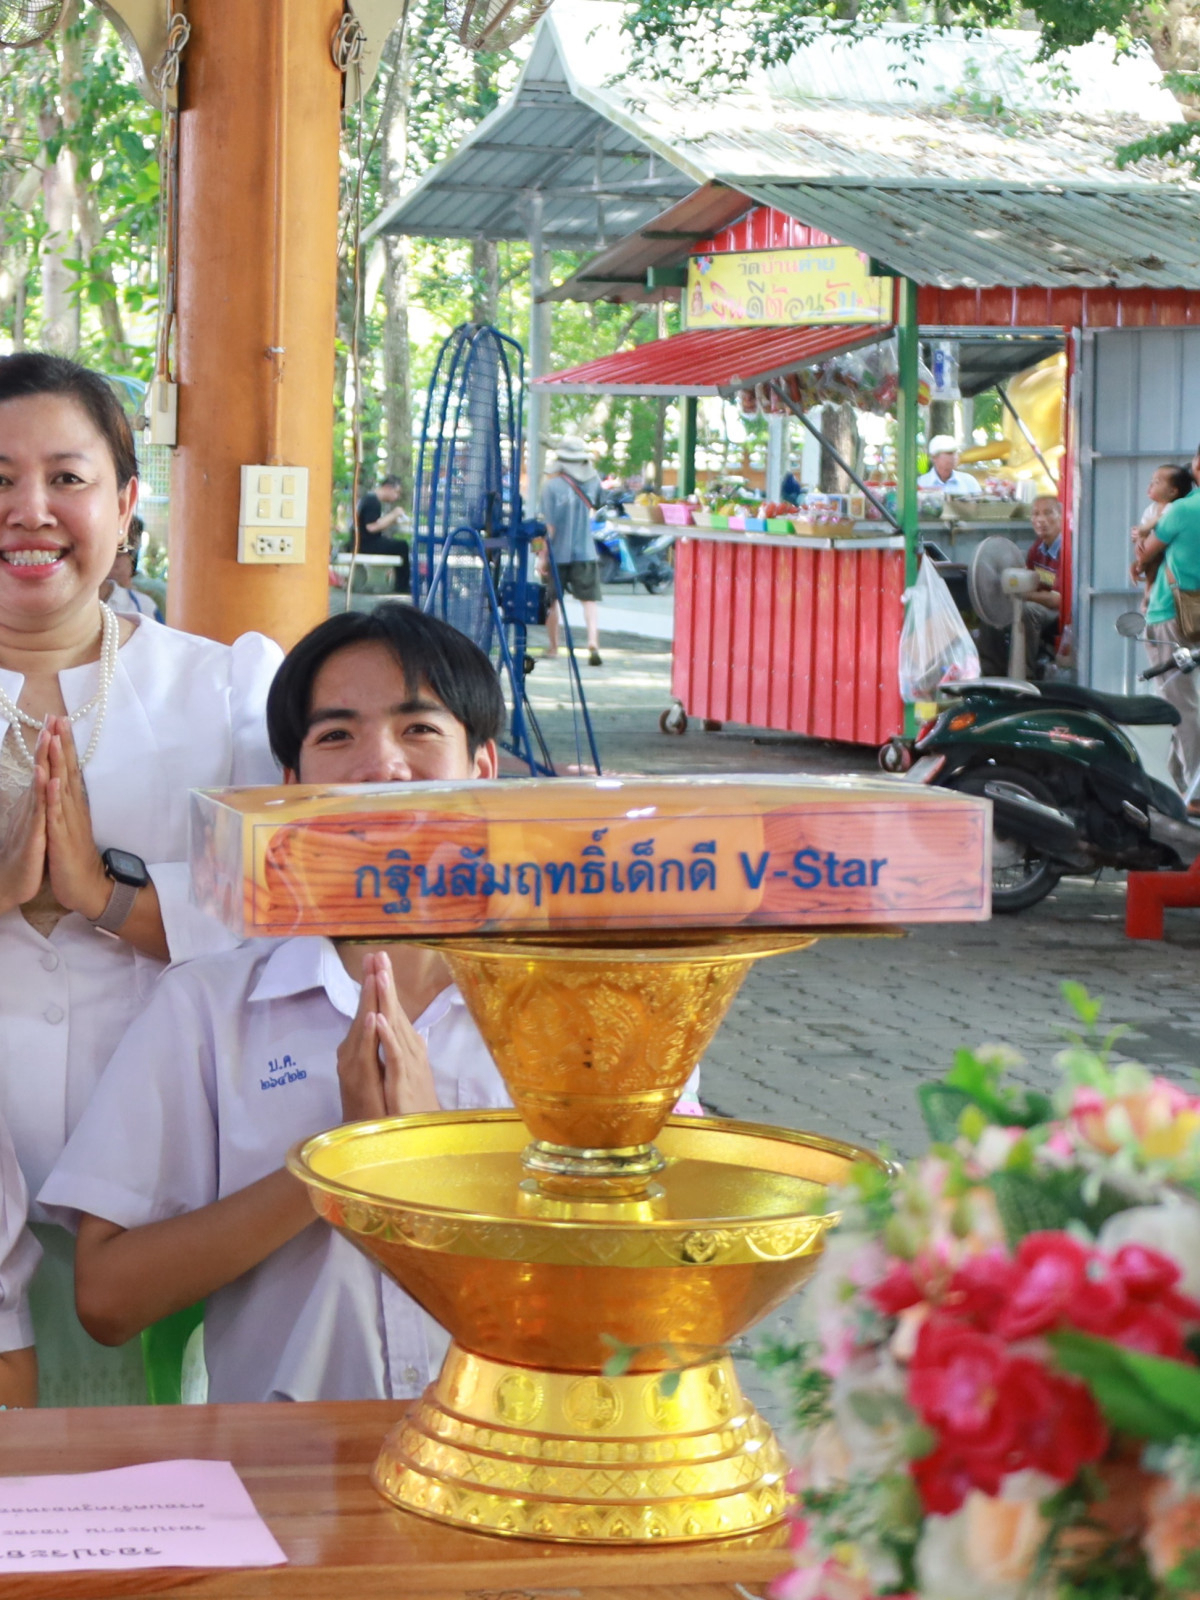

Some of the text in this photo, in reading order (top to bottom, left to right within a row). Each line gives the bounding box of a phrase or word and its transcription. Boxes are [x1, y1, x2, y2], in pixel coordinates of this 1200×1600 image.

[709, 279, 857, 321] ยินดีต้อนรับ
[354, 828, 888, 914] กฐินสัมฤทธิ์เด็กดี V-Star
